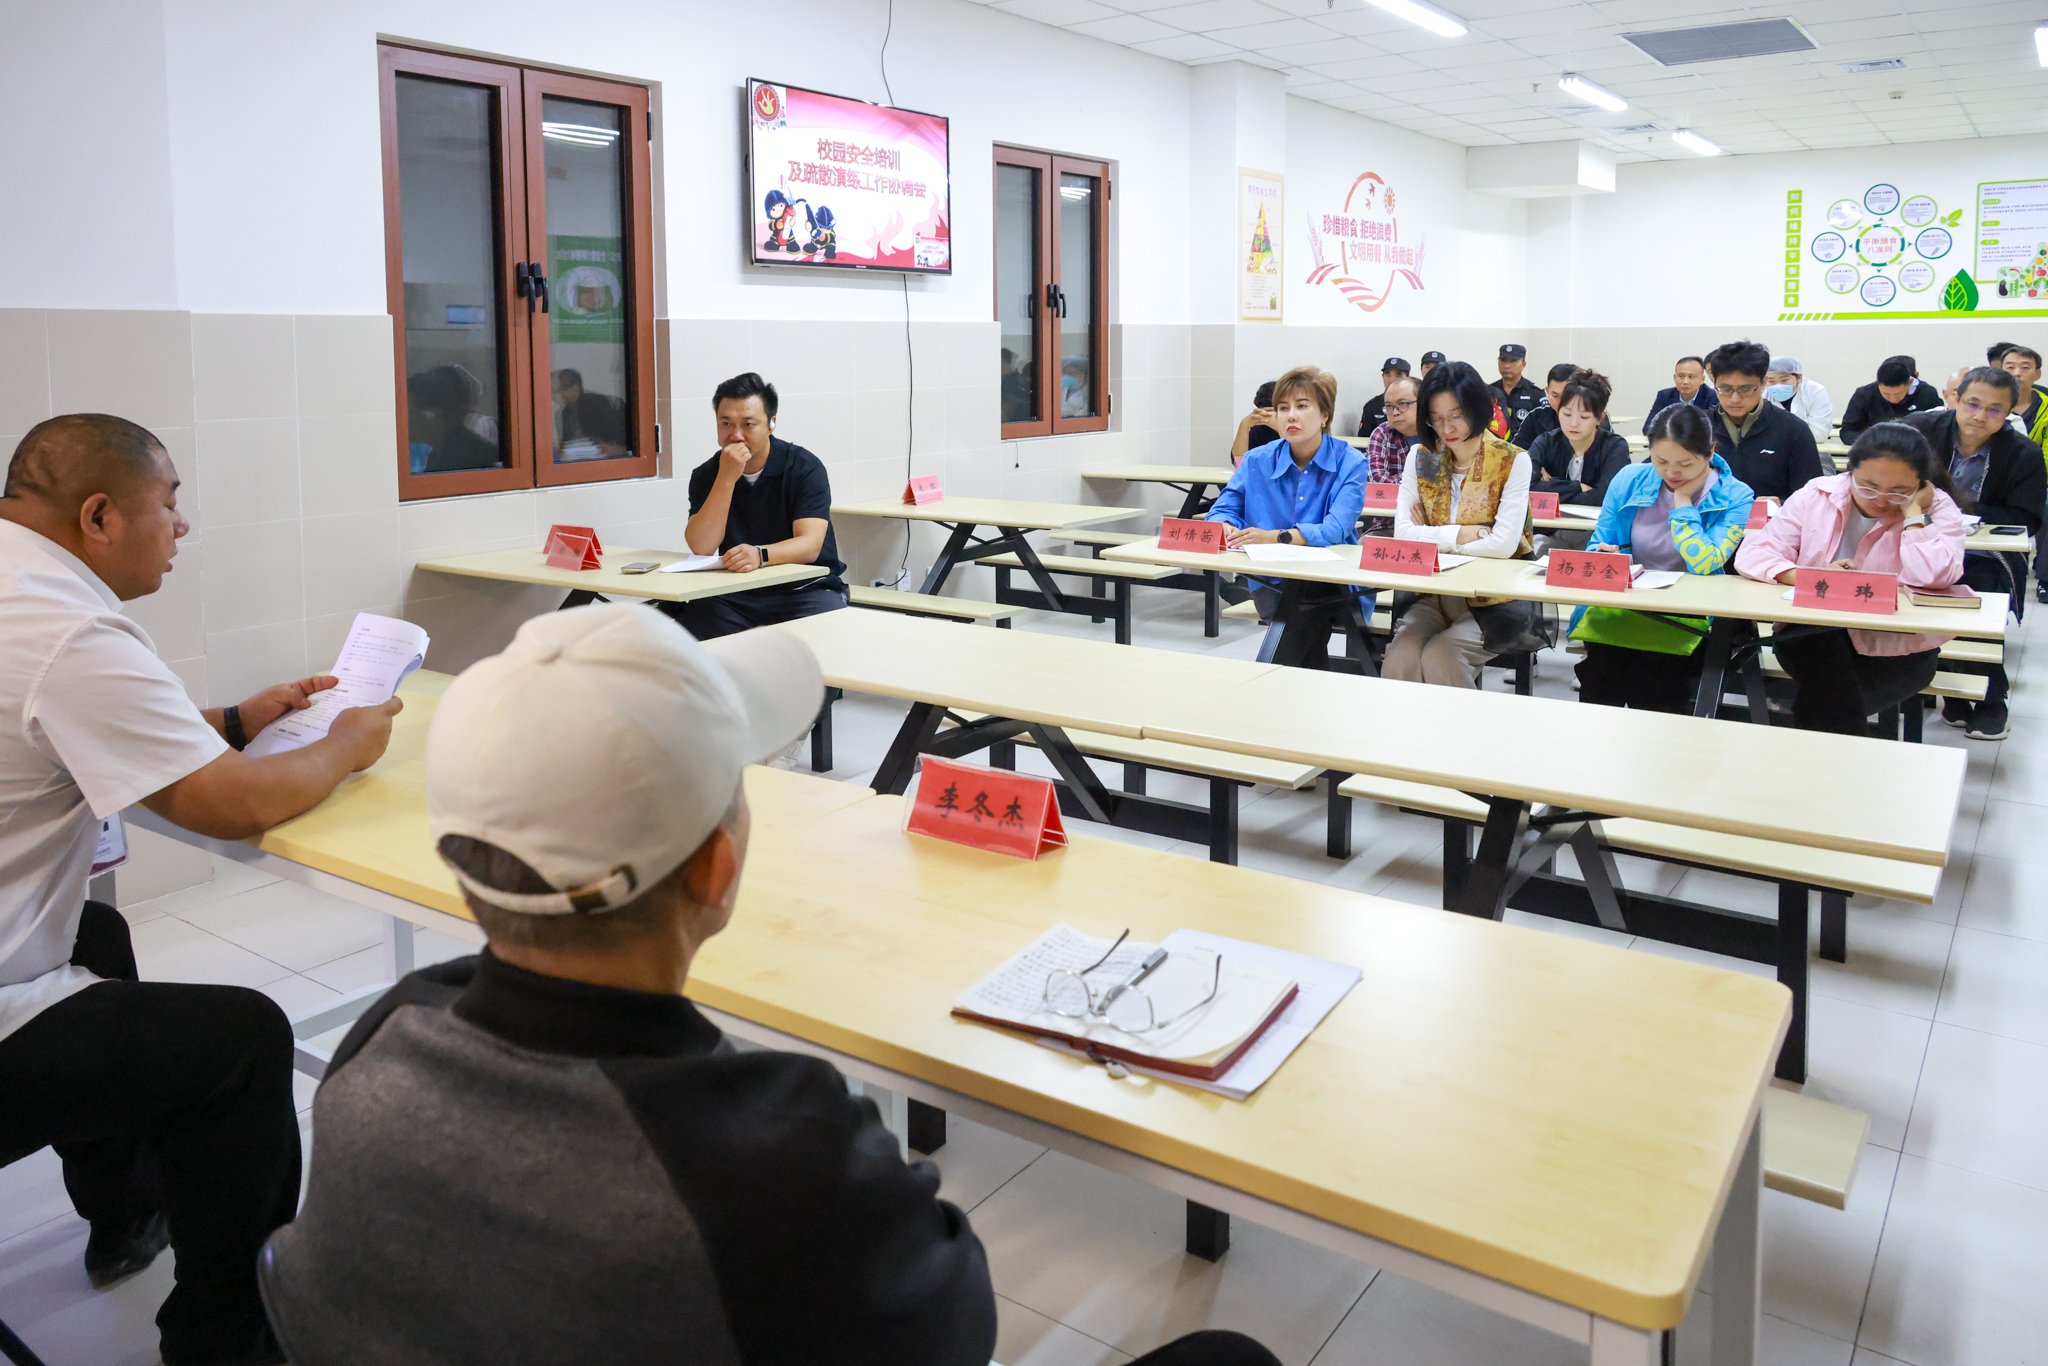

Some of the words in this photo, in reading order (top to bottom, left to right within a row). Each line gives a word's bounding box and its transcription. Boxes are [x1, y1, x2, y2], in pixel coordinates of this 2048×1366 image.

[817, 138, 901, 171] 校园安全培训
[787, 160, 927, 198] 及疏散演练工作协调会
[1322, 214, 1359, 238] 珍惜粮食
[1360, 219, 1392, 242] 拒绝浪费
[1349, 241, 1382, 263] 文明用餐
[1383, 244, 1414, 266] 从我做起
[1372, 547, 1423, 565] 孙小杰
[1557, 559, 1619, 579] 杨雪金
[1814, 579, 1874, 603] 曹玮
[935, 781, 1024, 831] 李冬杰
